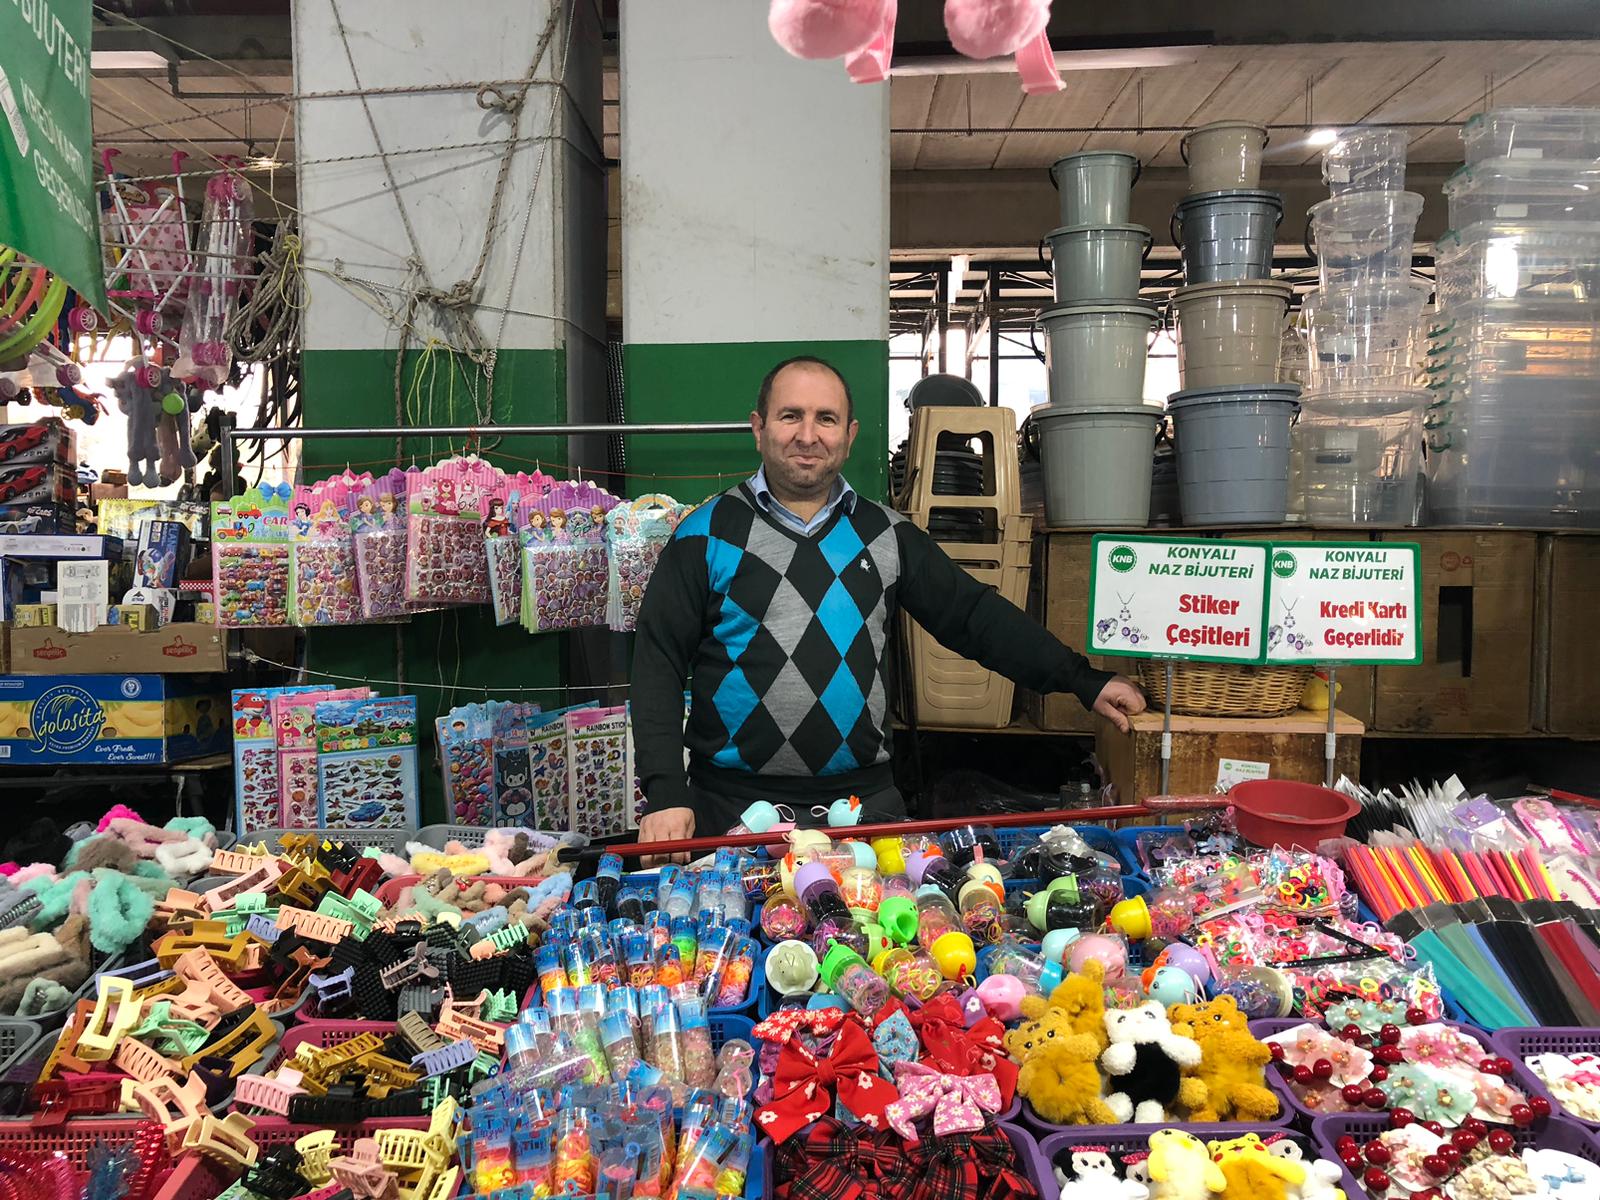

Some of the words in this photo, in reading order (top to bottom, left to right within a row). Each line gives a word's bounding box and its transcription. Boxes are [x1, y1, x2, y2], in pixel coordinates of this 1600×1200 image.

[1112, 554, 1133, 564] KNB
[1167, 546, 1236, 561] KONYALI
[1325, 550, 1387, 563] KONYALI
[1148, 563, 1182, 576] NAZ
[1184, 561, 1254, 579] BİJUTERİ
[1274, 559, 1294, 568] KNB
[1309, 567, 1339, 580] NAZ
[1342, 565, 1404, 581] BİJUTERİ
[1178, 593, 1240, 616] Stiker
[1320, 600, 1365, 619] Kredi
[1368, 601, 1407, 619] Kartı
[1166, 623, 1250, 647] Çeşitleri
[1324, 628, 1404, 649] Geçerlidir
[586, 723, 610, 733] RAINBOW
[107, 752, 125, 761] Ever
